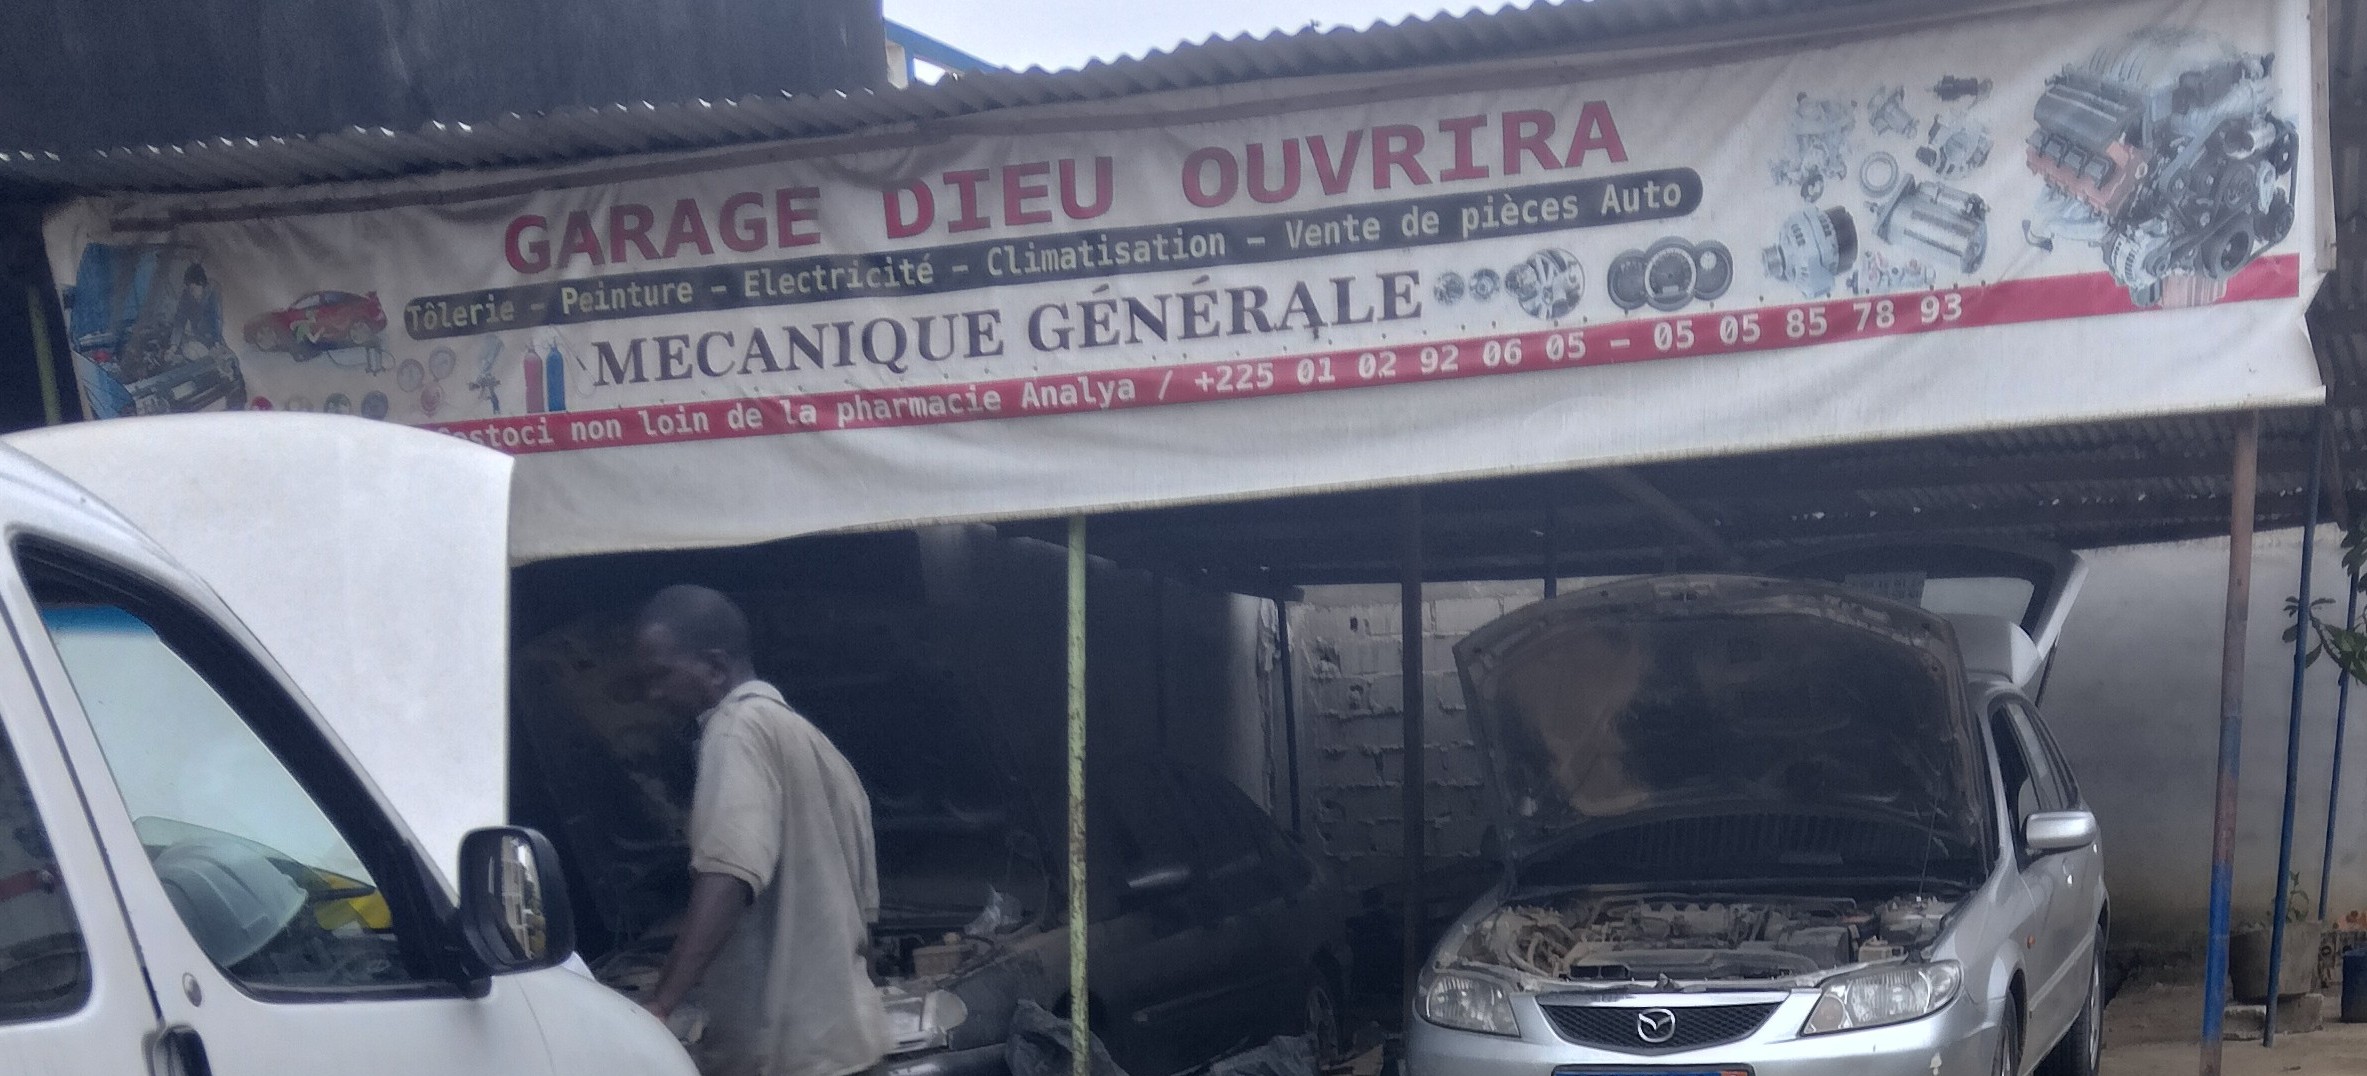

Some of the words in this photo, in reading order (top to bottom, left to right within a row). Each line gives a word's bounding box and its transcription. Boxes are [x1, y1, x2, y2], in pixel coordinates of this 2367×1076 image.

[405, 293, 519, 331] Tôlerie
[561, 278, 693, 315] Peinture
[743, 256, 934, 298] Electricité
[986, 228, 1226, 277] Climatisation
[1286, 213, 1381, 251] Vente
[1402, 205, 1441, 235] de
[1462, 193, 1579, 239] pièces
[1600, 180, 1682, 216] Auto
[505, 186, 822, 274] GARAGE
[882, 156, 1114, 239] DIEU
[1181, 100, 1629, 208] OUVRIRA
[571, 416, 621, 443] non
[639, 406, 709, 438] loin
[727, 402, 764, 431] de
[779, 399, 818, 426] la
[836, 385, 1002, 429] pharmacie
[1021, 375, 1137, 413] Analya
[1157, 370, 1174, 401] /
[1194, 361, 1274, 395] +225
[1296, 356, 1336, 386] 01
[1357, 350, 1398, 380] 02
[1420, 344, 1459, 376] 92
[1482, 338, 1522, 369] 06
[1545, 331, 1587, 362] 05
[1653, 320, 1696, 353] 05
[1718, 313, 1761, 346] 05
[1785, 306, 1828, 338] 85
[1852, 300, 1896, 333] 78
[1920, 293, 1963, 325] 93
[592, 308, 1004, 386] MECANIQUE
[1027, 271, 1423, 352] GÉNÉRALE
